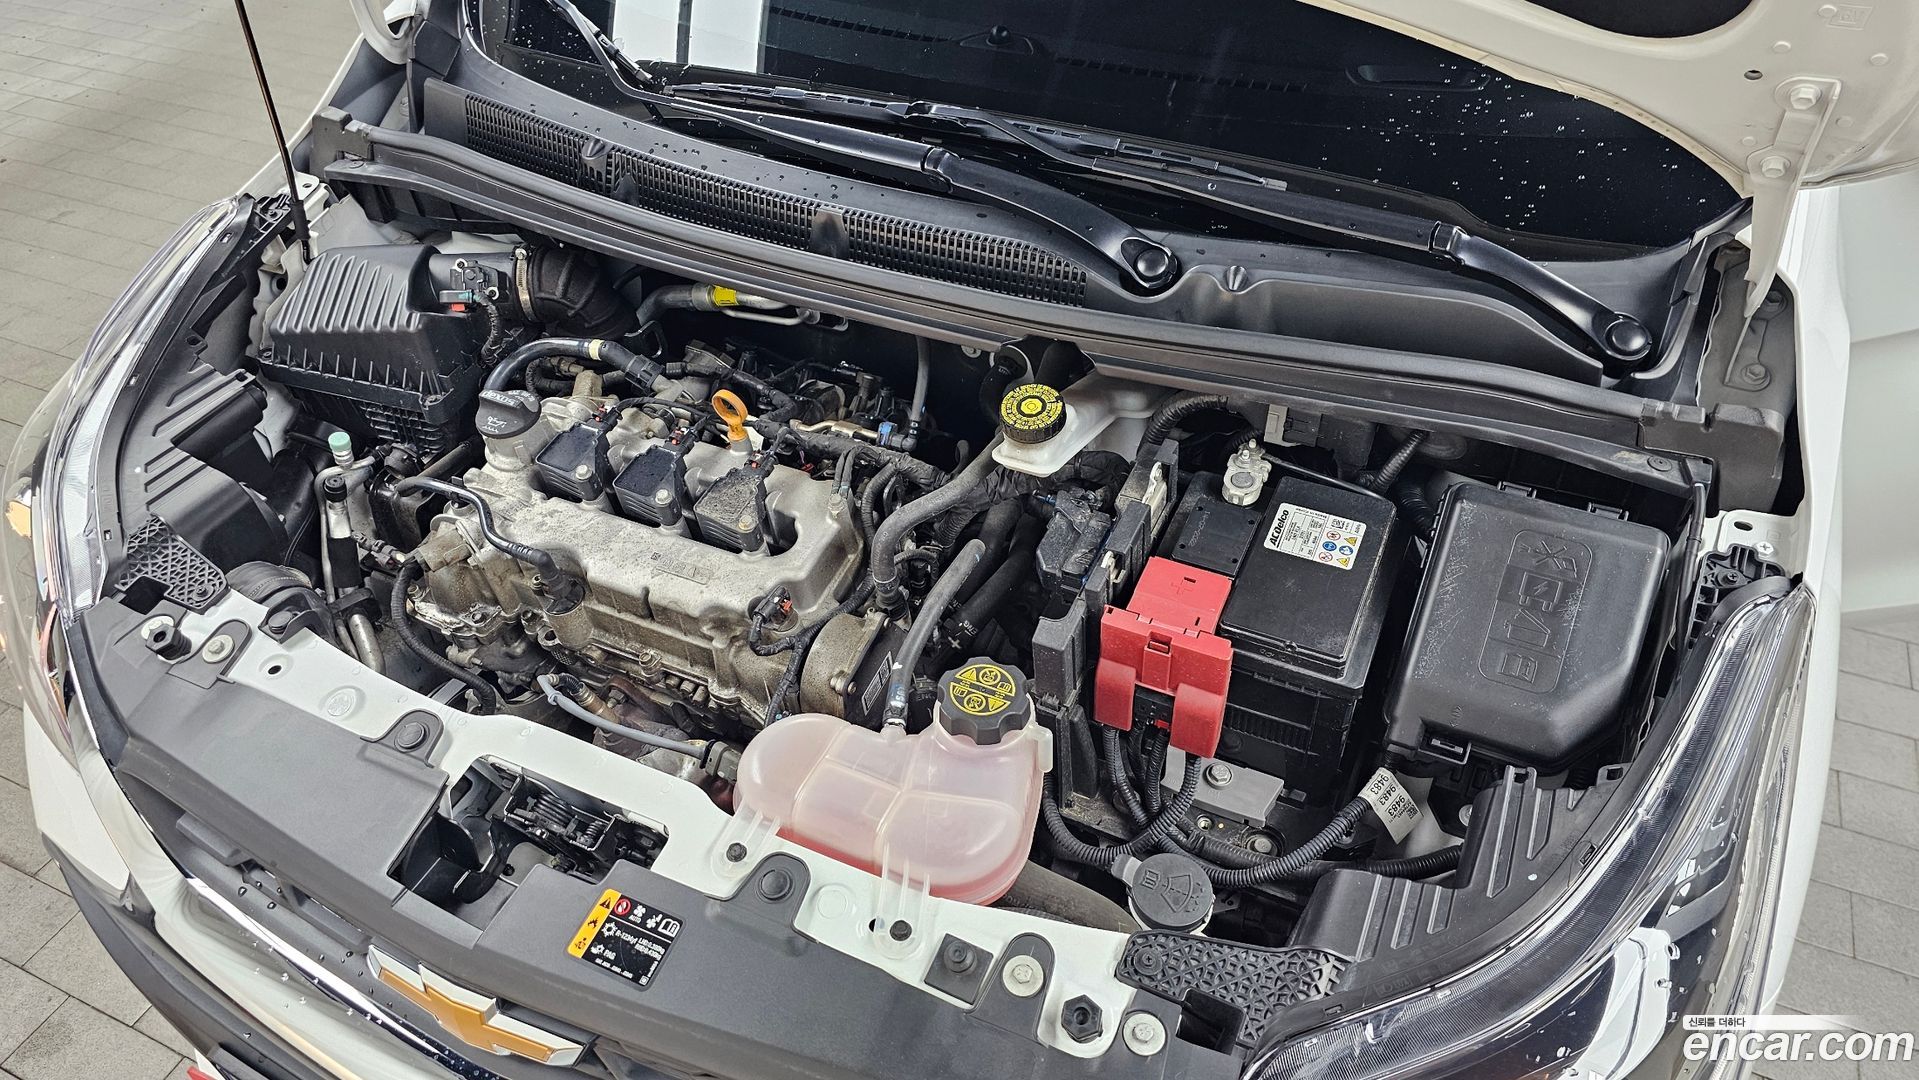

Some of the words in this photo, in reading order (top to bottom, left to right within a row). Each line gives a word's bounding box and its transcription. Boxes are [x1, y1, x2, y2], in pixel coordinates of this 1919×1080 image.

[1270, 509, 1290, 546] ACDelco
[1370, 774, 1390, 795] 9483
[1379, 784, 1397, 806] 9483
[1387, 795, 1406, 817] 9483
[603, 949, 617, 960] PAG
